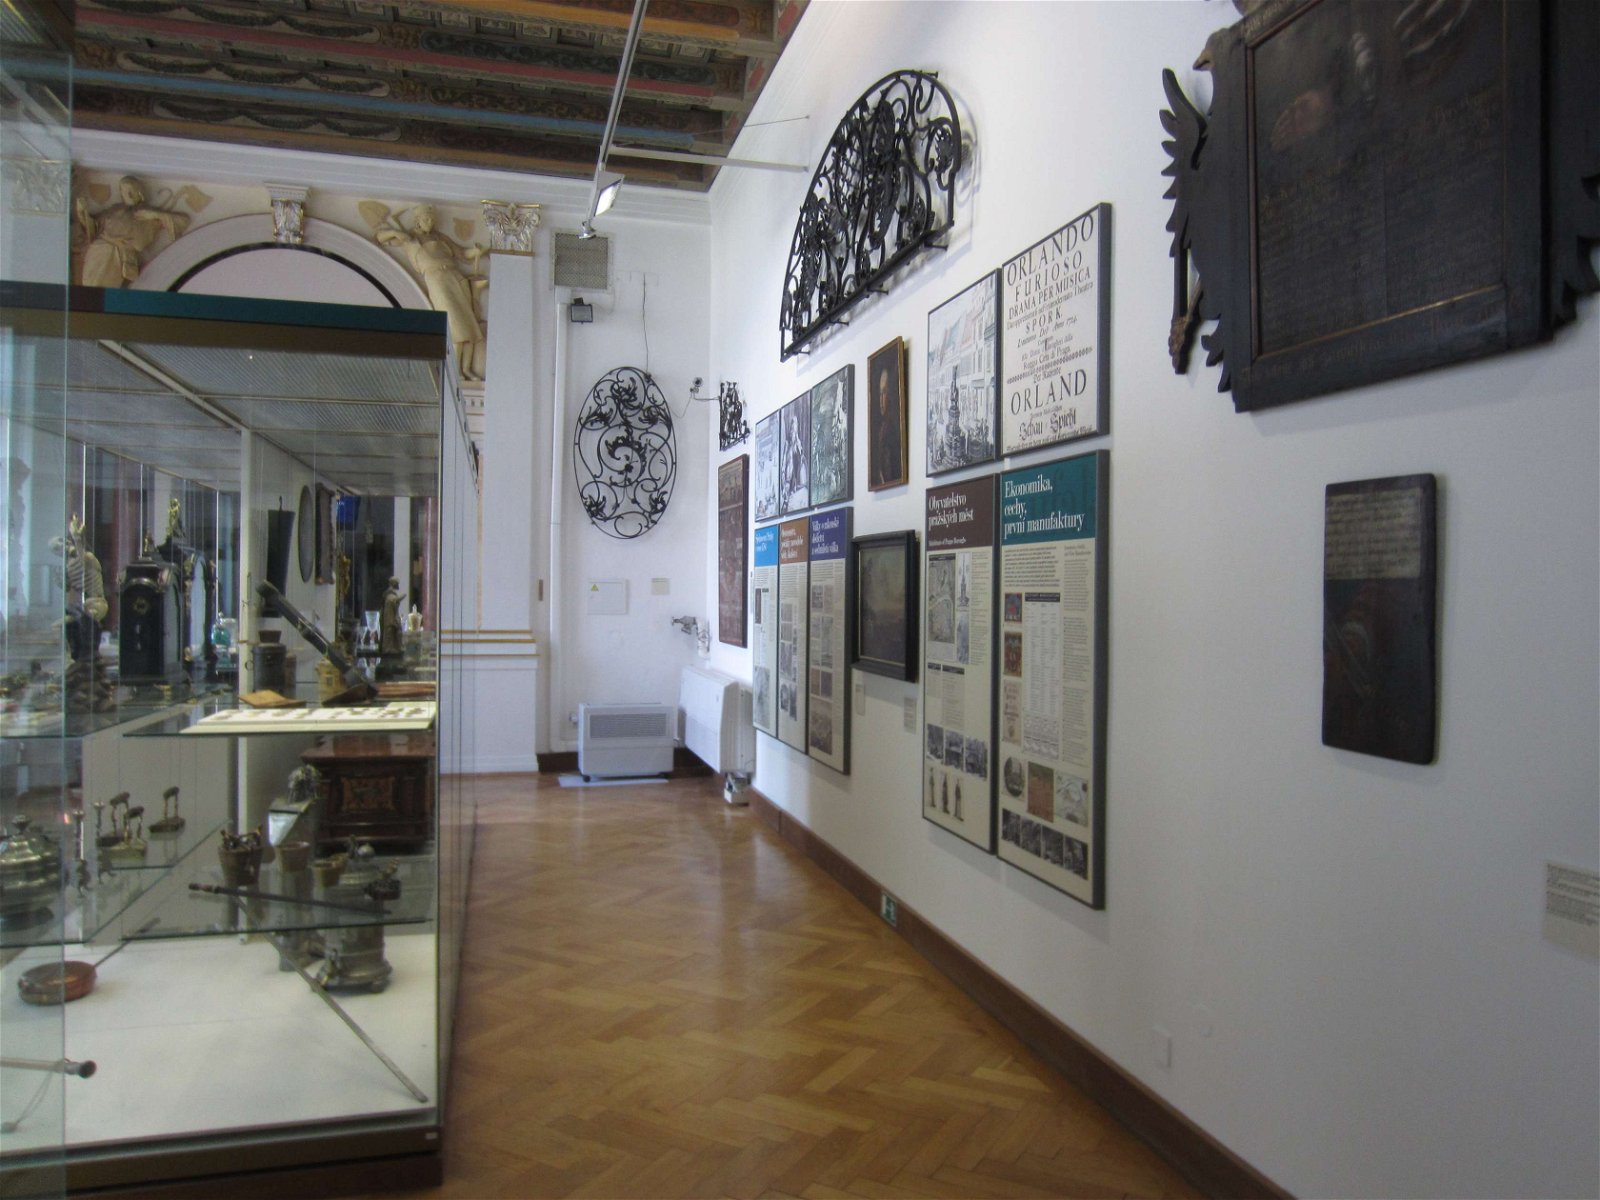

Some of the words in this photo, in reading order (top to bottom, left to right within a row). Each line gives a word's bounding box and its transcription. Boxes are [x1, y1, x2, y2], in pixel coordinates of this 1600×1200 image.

[1007, 213, 1094, 287] ORLANDO
[1009, 295, 1036, 320] DRAMA
[1038, 284, 1054, 305] PER
[1055, 266, 1091, 296] MUSICA
[1015, 250, 1082, 302] FURIOSO
[1011, 369, 1087, 416] ORLAND
[1004, 498, 1027, 519] cechy,
[1005, 474, 1053, 498] Ekonomika,
[1004, 517, 1025, 540] první
[1027, 510, 1085, 532] manufaktury
